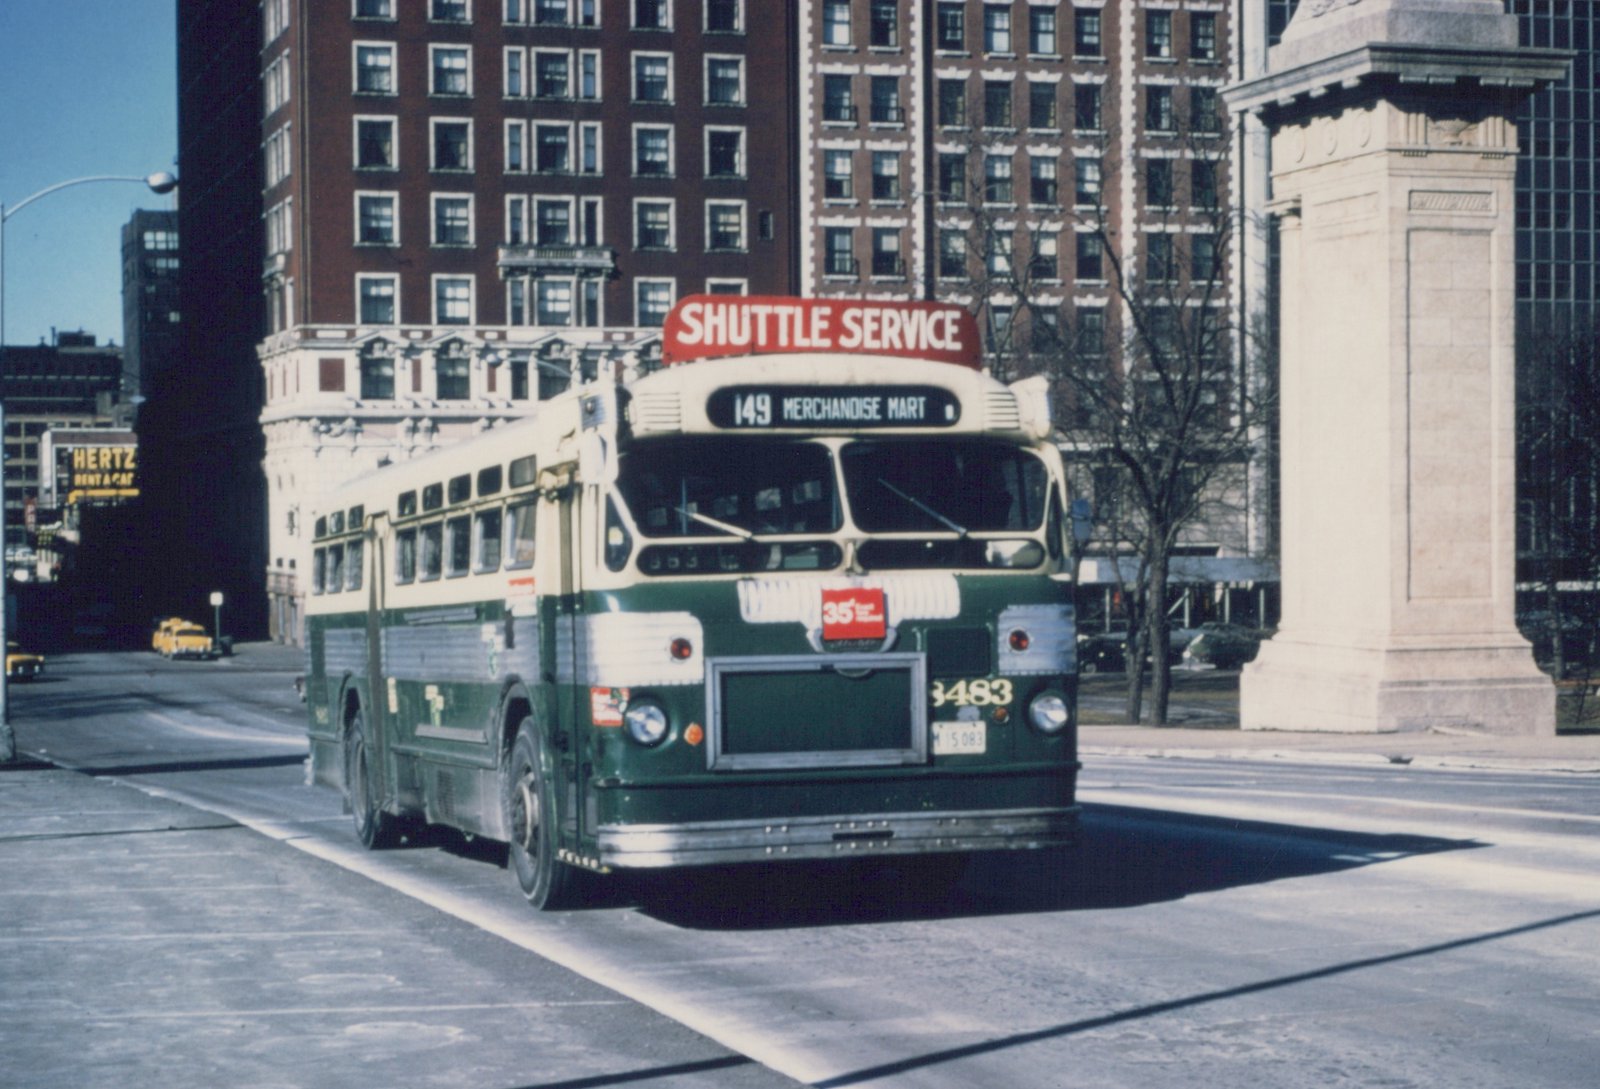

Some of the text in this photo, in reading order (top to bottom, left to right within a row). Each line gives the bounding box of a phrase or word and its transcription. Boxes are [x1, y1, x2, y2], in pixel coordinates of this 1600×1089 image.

[676, 303, 962, 350] SHUTTLE SERVICE
[735, 394, 926, 425] 149 MERCHANDISE MART
[74, 448, 135, 469] HERTZ
[102, 474, 111, 486] A
